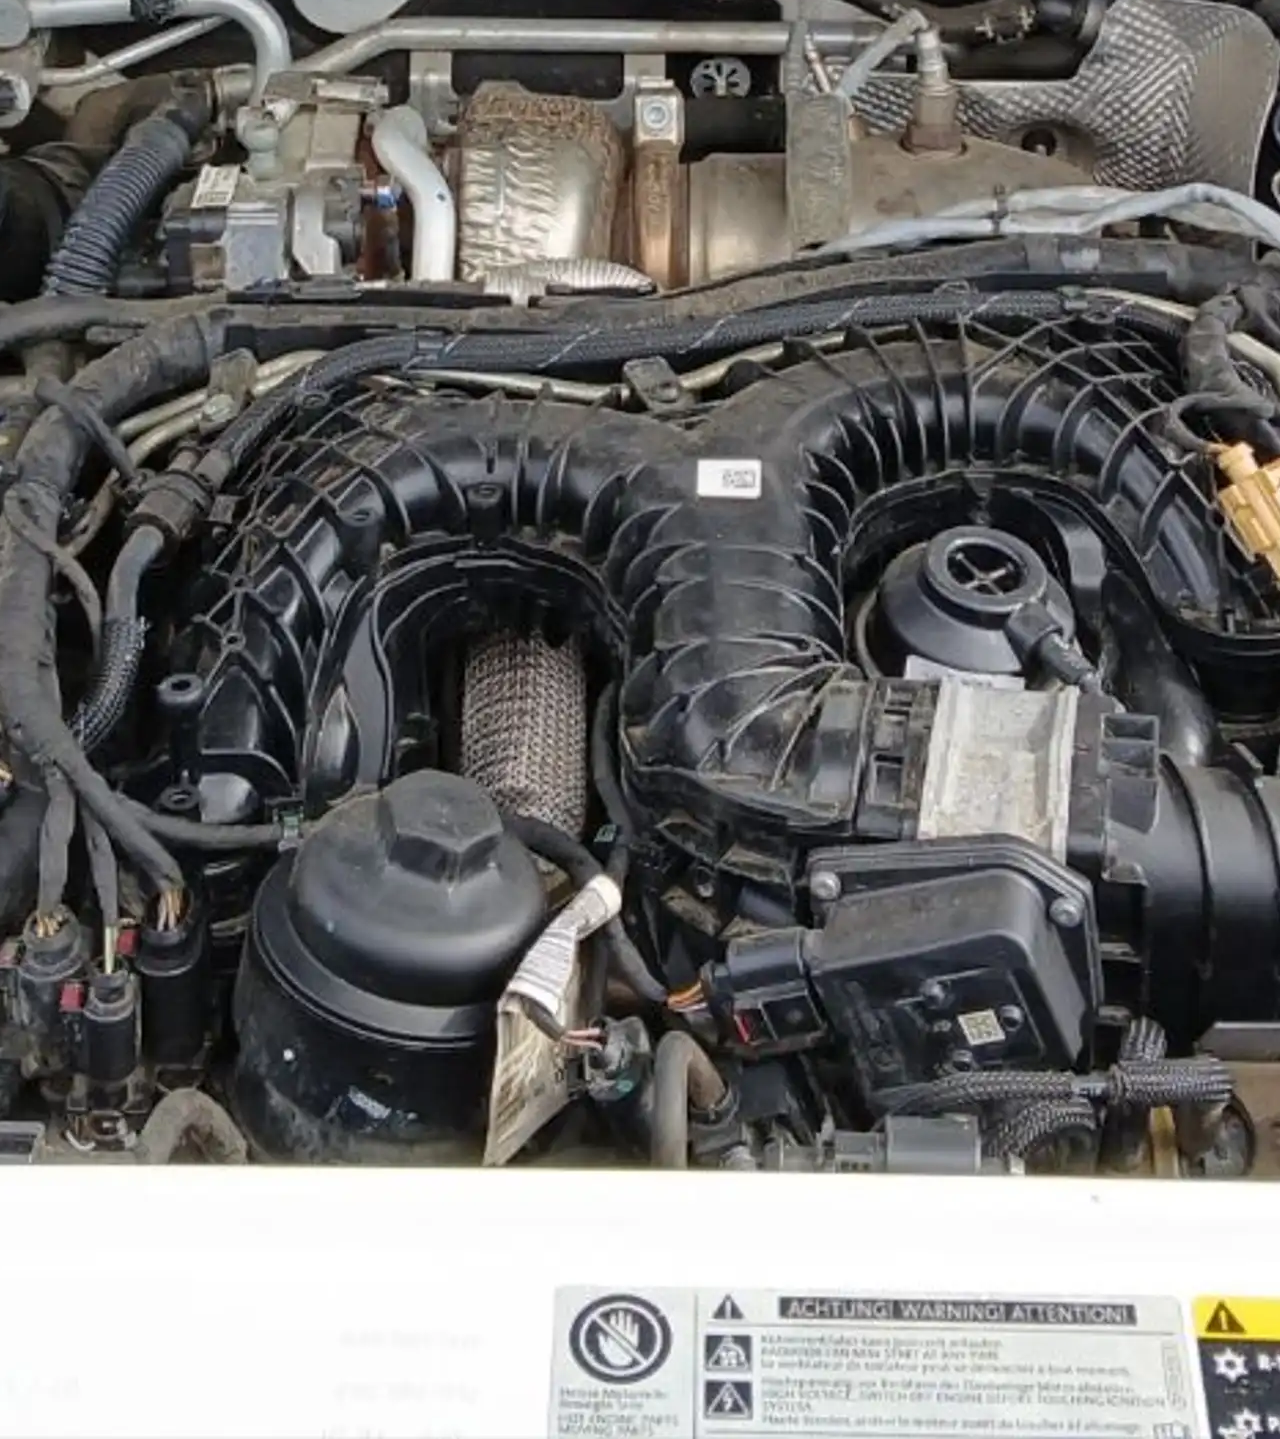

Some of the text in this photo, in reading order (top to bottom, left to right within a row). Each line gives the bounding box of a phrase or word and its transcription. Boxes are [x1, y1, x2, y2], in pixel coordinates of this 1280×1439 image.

[786, 1299, 1130, 1325] ACHTUNG! WARNING! ATTENTION!
